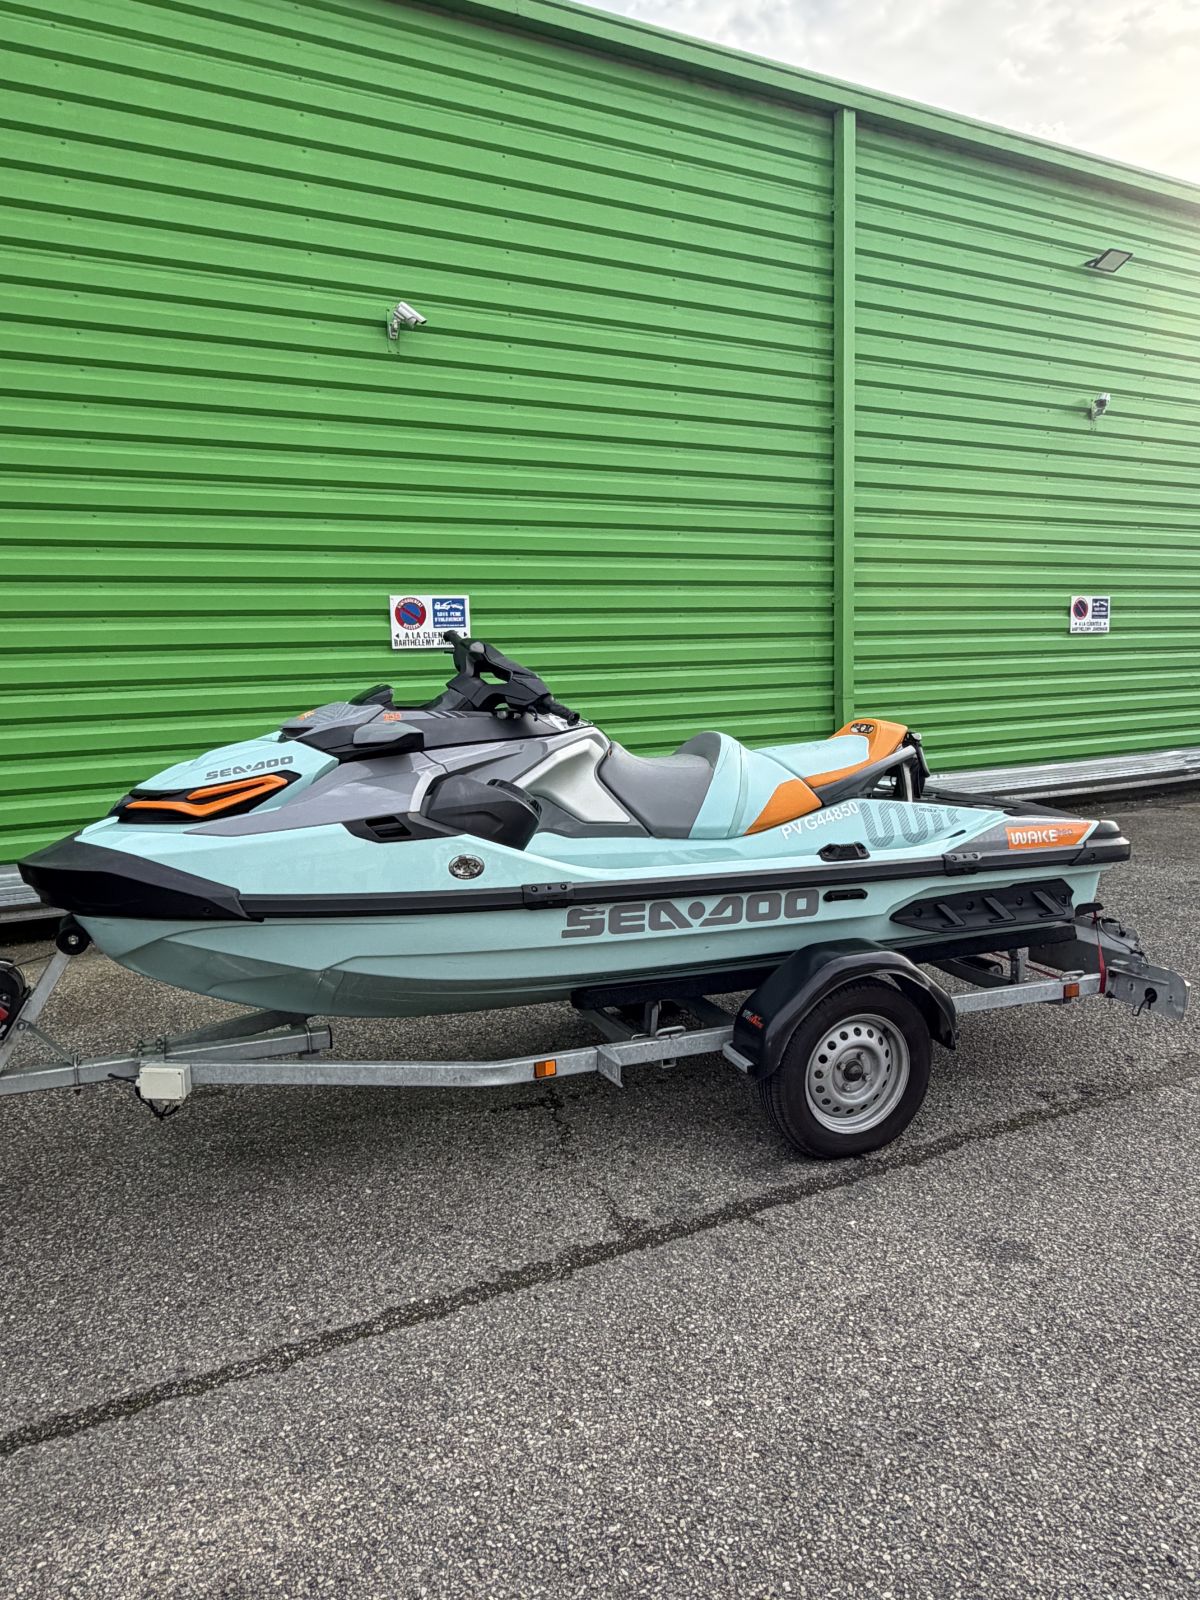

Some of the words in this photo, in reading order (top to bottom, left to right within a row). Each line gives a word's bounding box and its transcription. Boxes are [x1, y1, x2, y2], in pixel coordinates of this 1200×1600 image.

[405, 631, 410, 639] A
[411, 631, 421, 639] LA
[394, 638, 435, 647] BARTHELEMY
[780, 820, 804, 840] PV
[804, 801, 860, 831] G44850
[1011, 829, 1058, 845] WAKE
